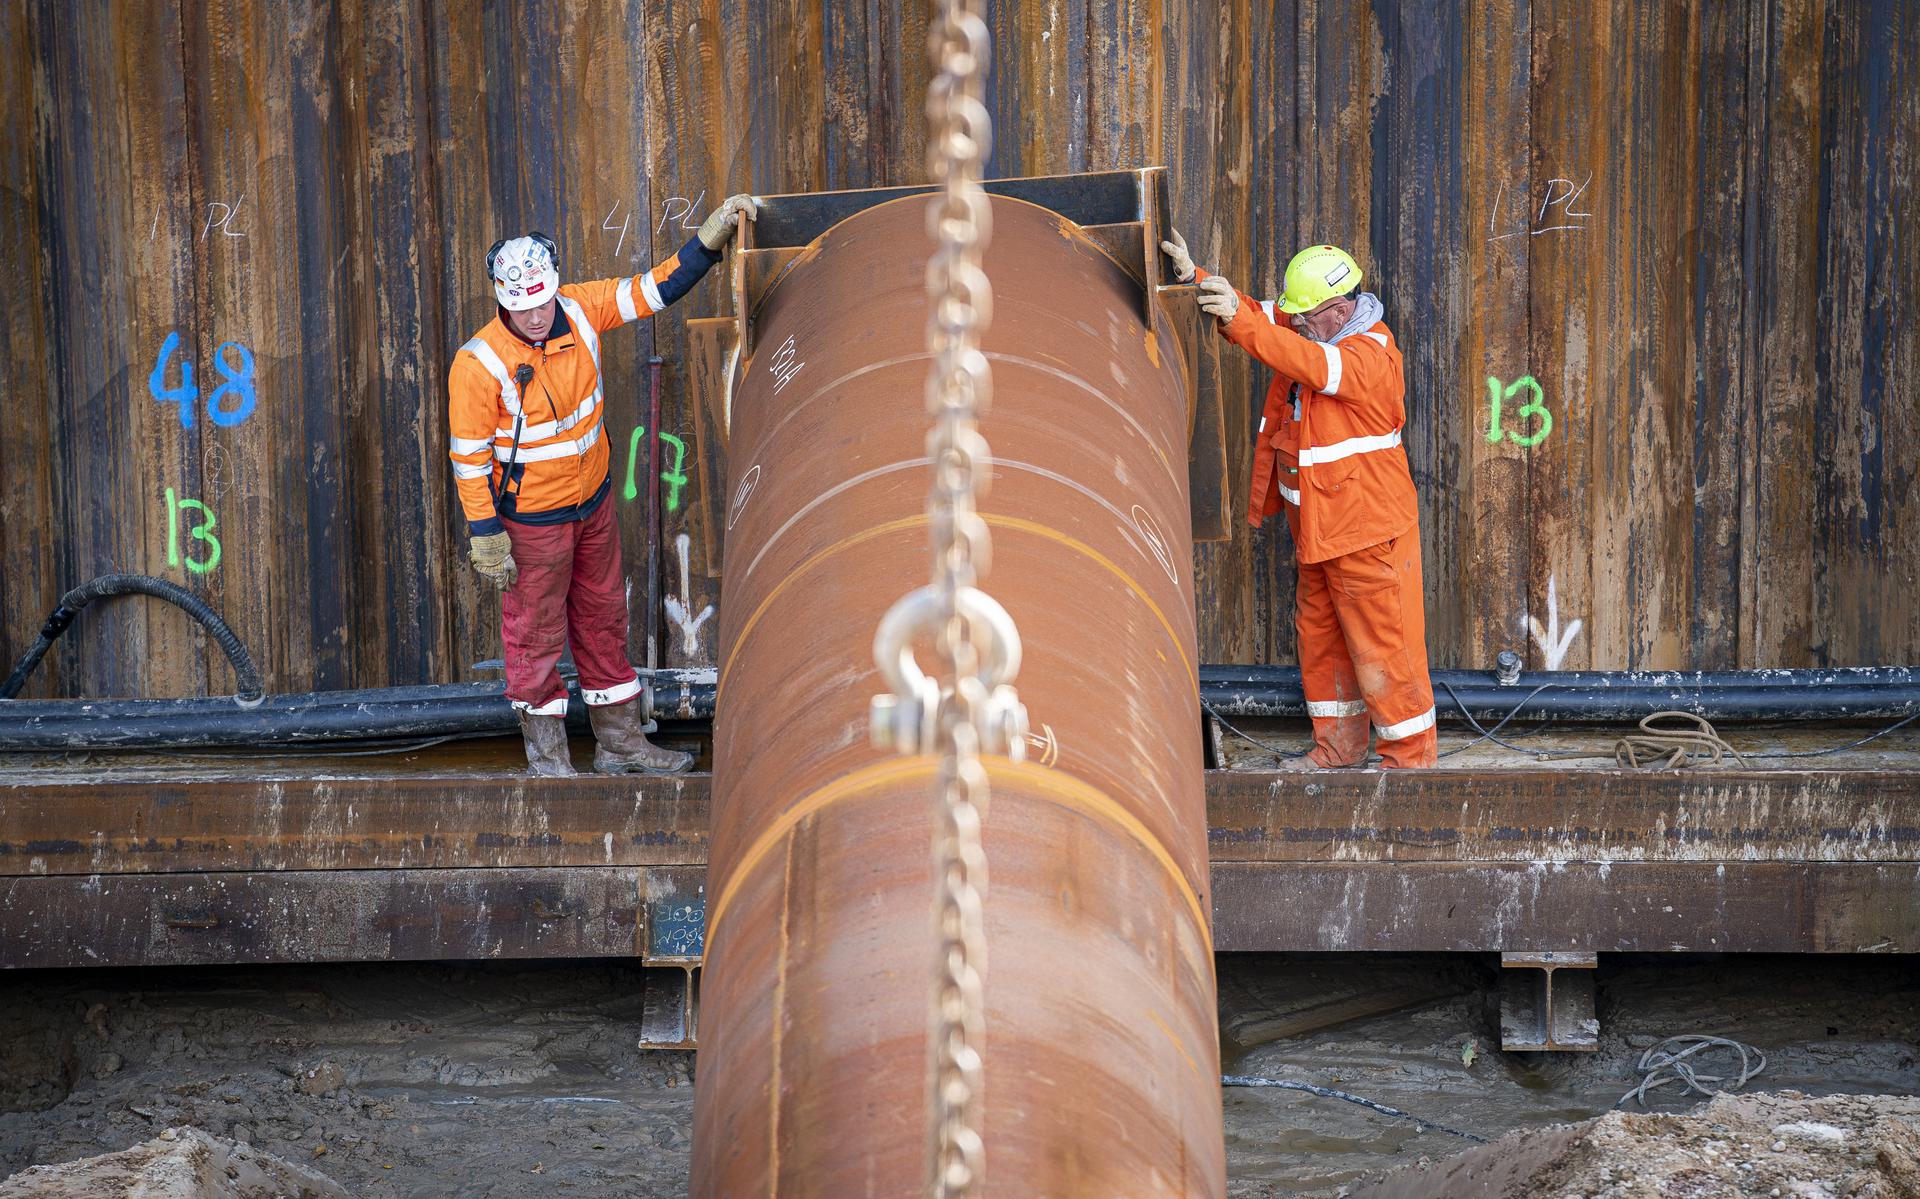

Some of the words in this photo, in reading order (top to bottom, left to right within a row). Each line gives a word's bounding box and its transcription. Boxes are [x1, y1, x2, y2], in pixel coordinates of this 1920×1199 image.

[200, 193, 246, 244] PL
[602, 199, 630, 257] 4
[656, 190, 705, 234] PL
[1539, 170, 1593, 221] PL
[148, 331, 257, 430] 48
[1487, 375, 1553, 447] 13
[623, 425, 688, 512] 17
[165, 486, 222, 575] 13
